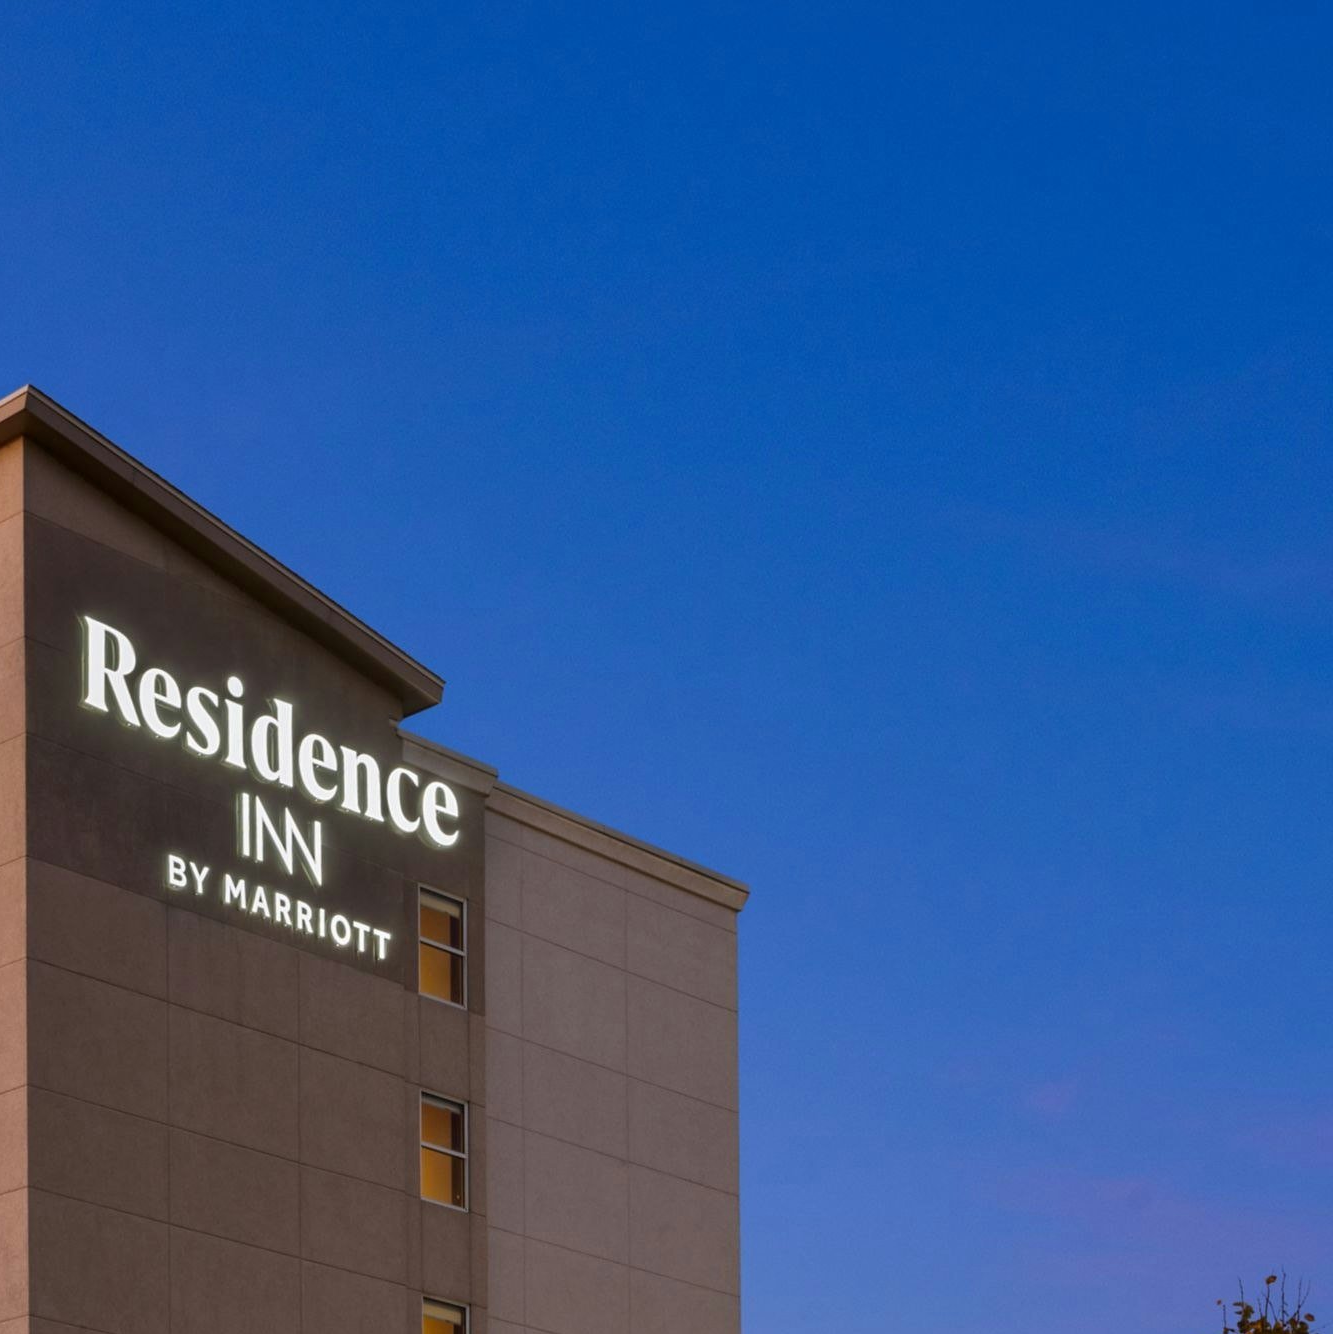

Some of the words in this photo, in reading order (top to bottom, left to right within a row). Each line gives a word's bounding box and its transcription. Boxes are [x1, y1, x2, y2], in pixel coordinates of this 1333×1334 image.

[81, 615, 460, 847] Residence
[240, 792, 323, 887] INN
[167, 853, 210, 895] BY
[223, 874, 392, 961] MARRIOTT
